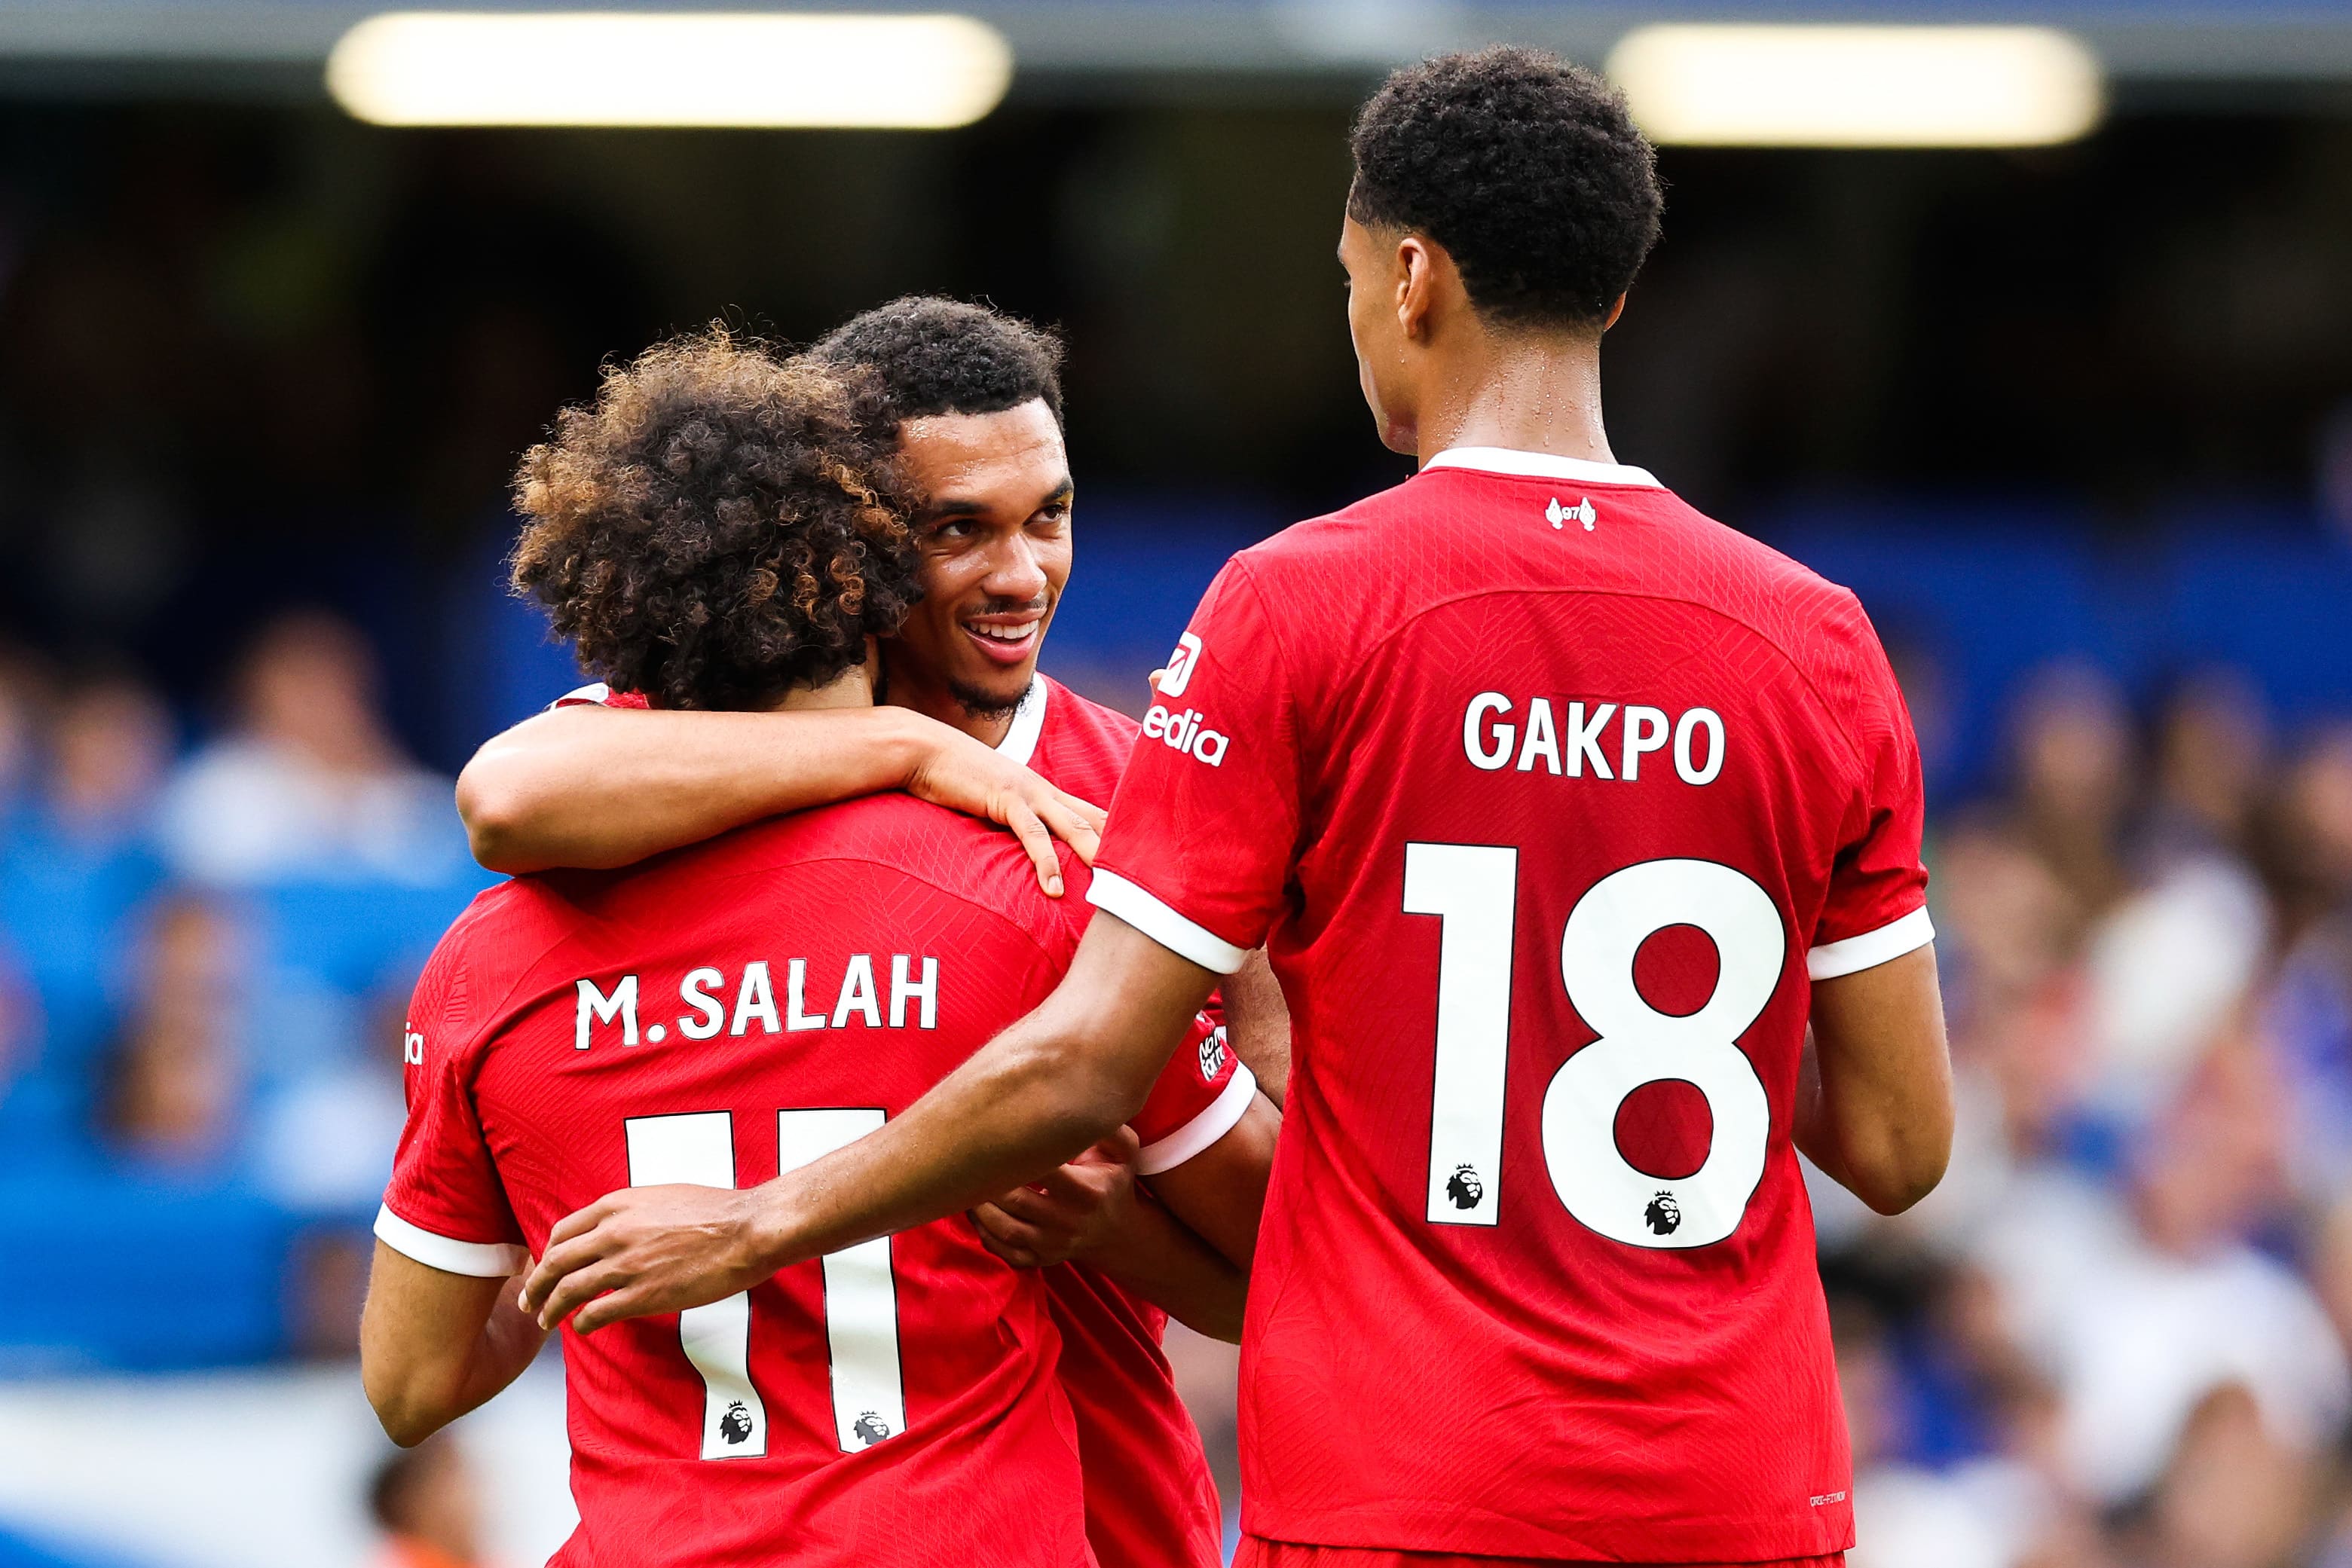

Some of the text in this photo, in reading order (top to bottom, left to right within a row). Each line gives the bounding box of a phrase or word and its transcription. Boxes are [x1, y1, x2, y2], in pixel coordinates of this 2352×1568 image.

[1561, 506, 1580, 521] 97
[1463, 691, 1726, 786] GAKPO
[1402, 840, 1787, 1250] 18
[623, 1107, 906, 1461] 11
